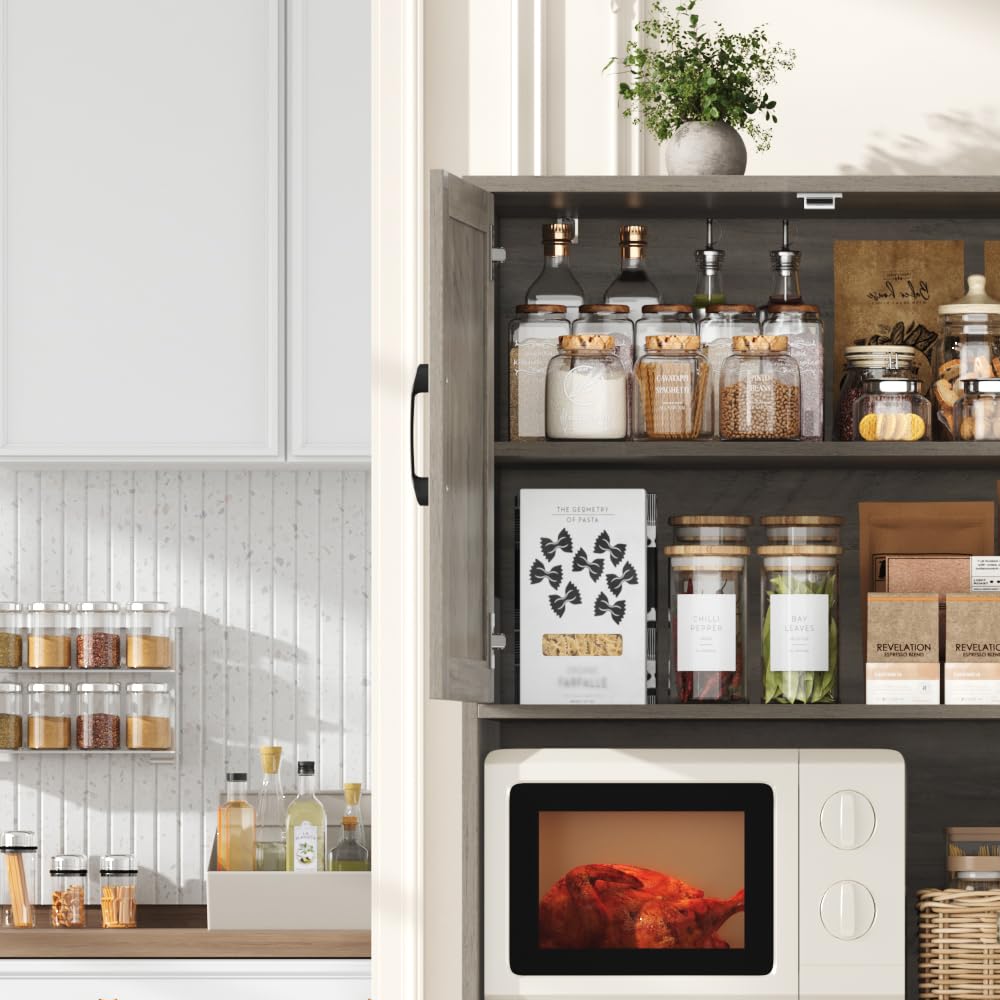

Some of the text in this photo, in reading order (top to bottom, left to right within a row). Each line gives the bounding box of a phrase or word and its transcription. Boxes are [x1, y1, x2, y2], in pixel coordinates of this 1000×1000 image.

[692, 615, 720, 623] CHILLI
[791, 615, 808, 623] BAY
[690, 624, 723, 632] PEPPER
[784, 624, 816, 632] LEAVES
[876, 643, 931, 652] REVELATION
